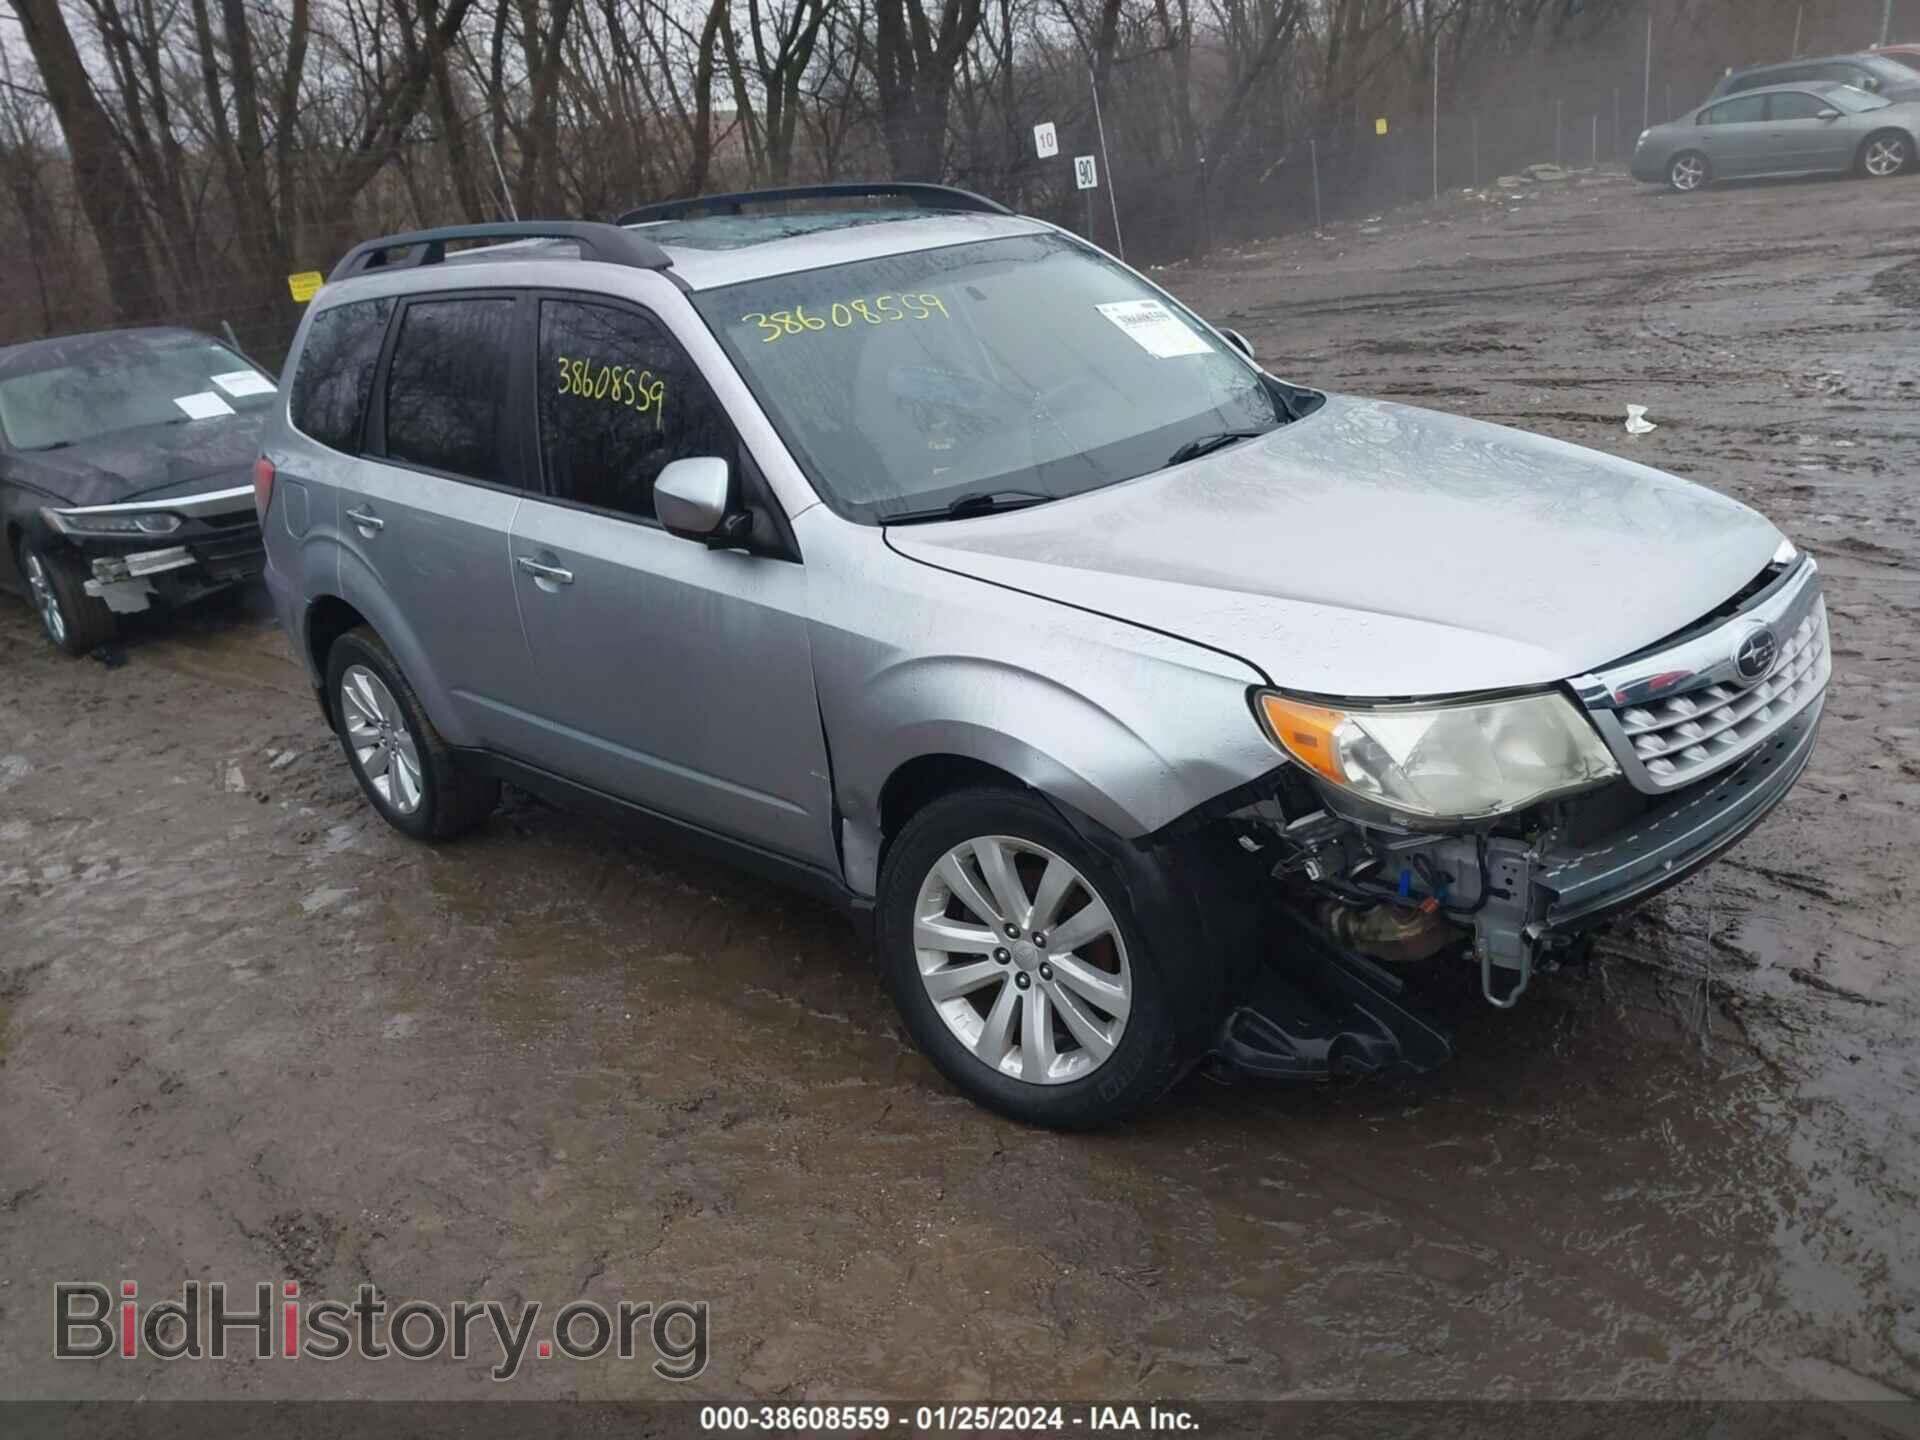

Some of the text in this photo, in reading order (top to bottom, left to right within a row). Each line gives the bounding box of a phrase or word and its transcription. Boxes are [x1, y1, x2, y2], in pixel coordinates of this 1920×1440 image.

[1040, 132, 1054, 149] 10
[1079, 160, 1093, 185] 90
[741, 293, 950, 343] 38608559
[557, 356, 665, 430] 38608559
